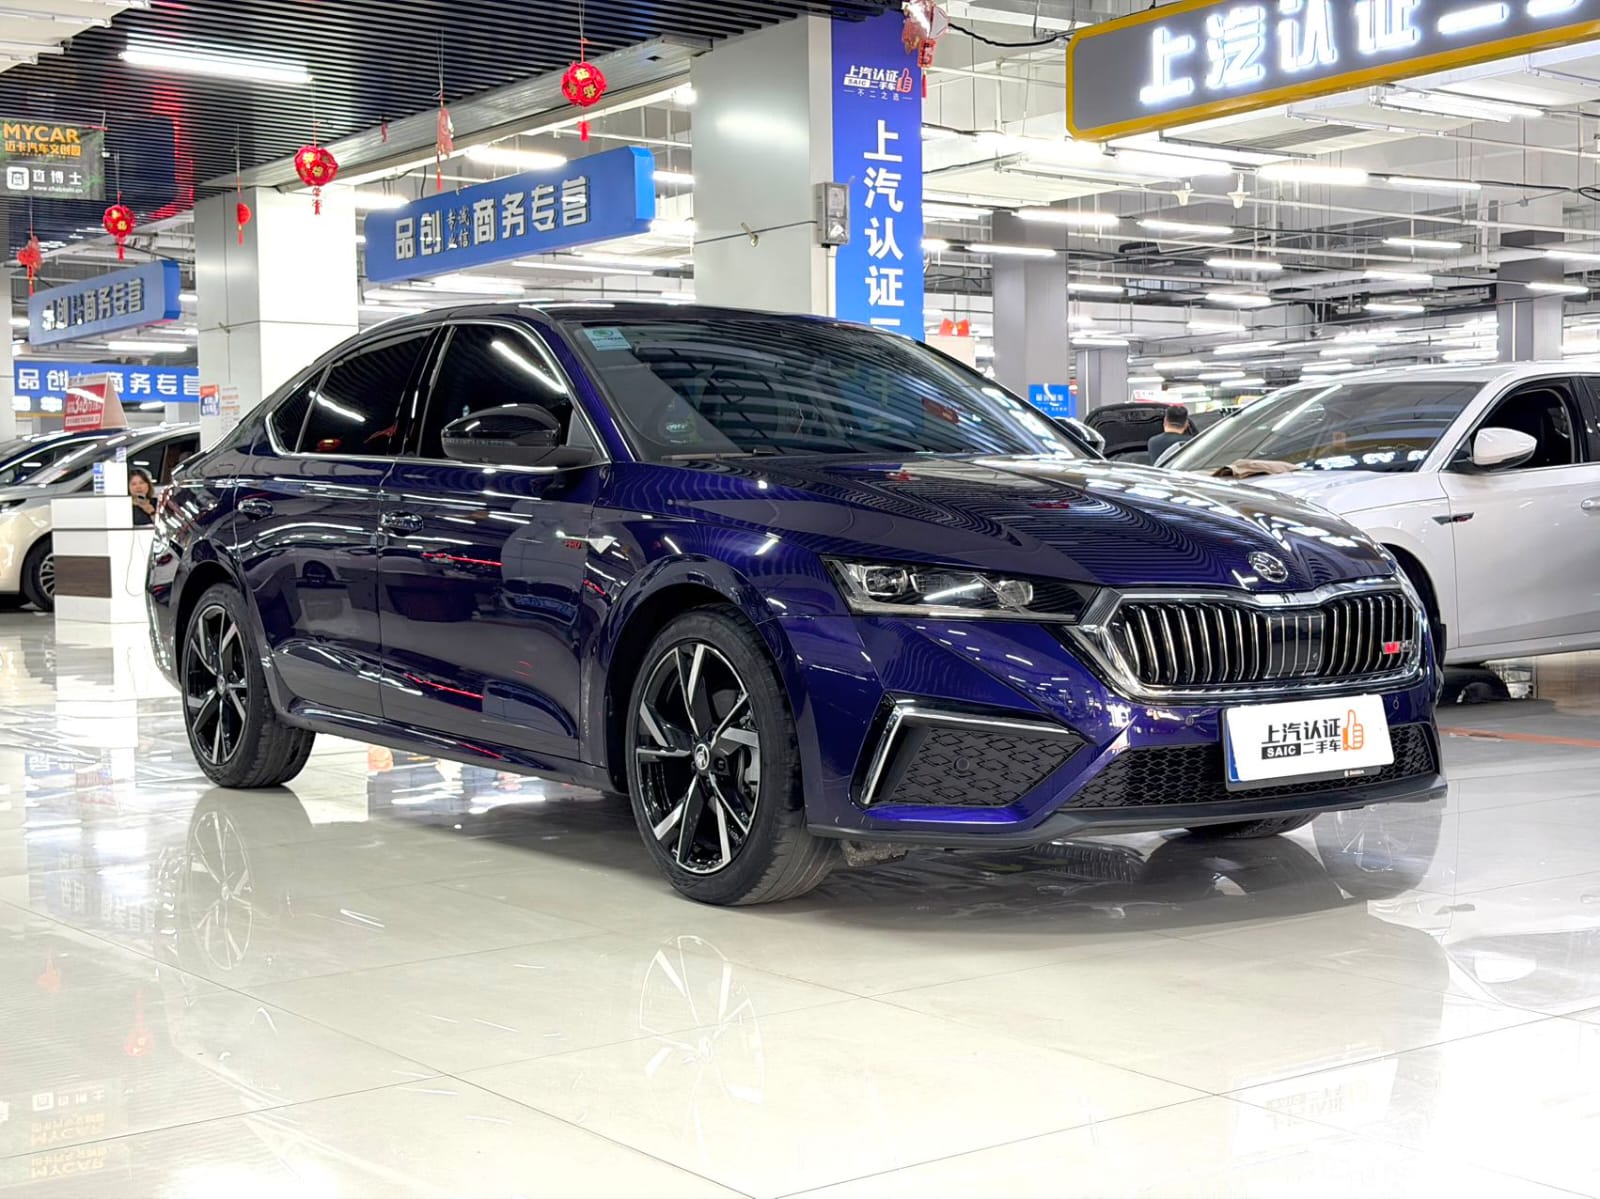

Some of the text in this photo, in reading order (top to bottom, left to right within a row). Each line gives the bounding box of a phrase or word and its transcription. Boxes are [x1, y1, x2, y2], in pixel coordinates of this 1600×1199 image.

[1138, 0, 1582, 104] 上汽认证
[845, 65, 899, 82] 上汽认证
[847, 78, 897, 91] SAIC 二手车
[3, 123, 80, 144] MYCAR
[395, 208, 443, 260] 品创
[472, 175, 589, 246] 商务专营
[18, 368, 67, 392] 品创
[1261, 717, 1341, 745] 上汽认证
[1266, 739, 1341, 758] SAIC 二手车
